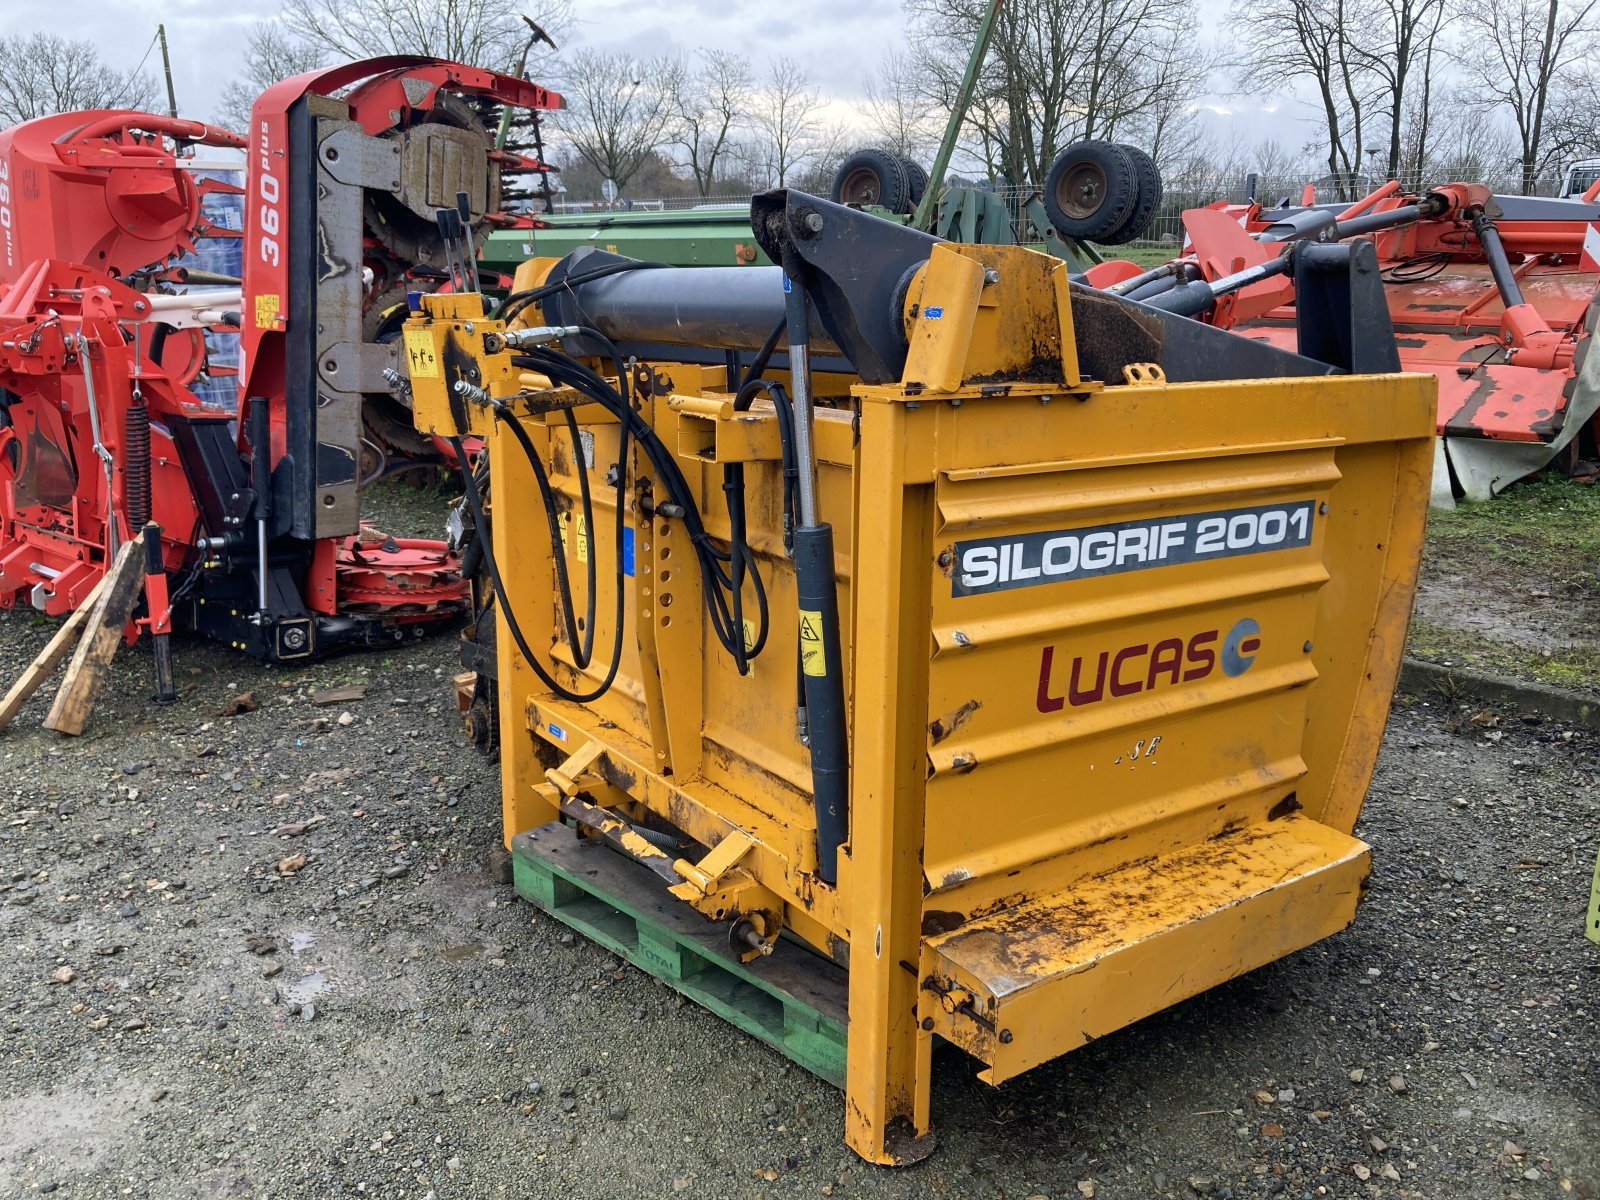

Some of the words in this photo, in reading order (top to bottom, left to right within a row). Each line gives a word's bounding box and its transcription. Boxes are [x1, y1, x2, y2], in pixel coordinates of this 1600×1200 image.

[259, 121, 271, 171] plus
[260, 173, 279, 267] 360
[962, 522, 1187, 587] SILOGRIF
[1195, 507, 1310, 553] 2001
[1036, 629, 1219, 713] LUCAS
